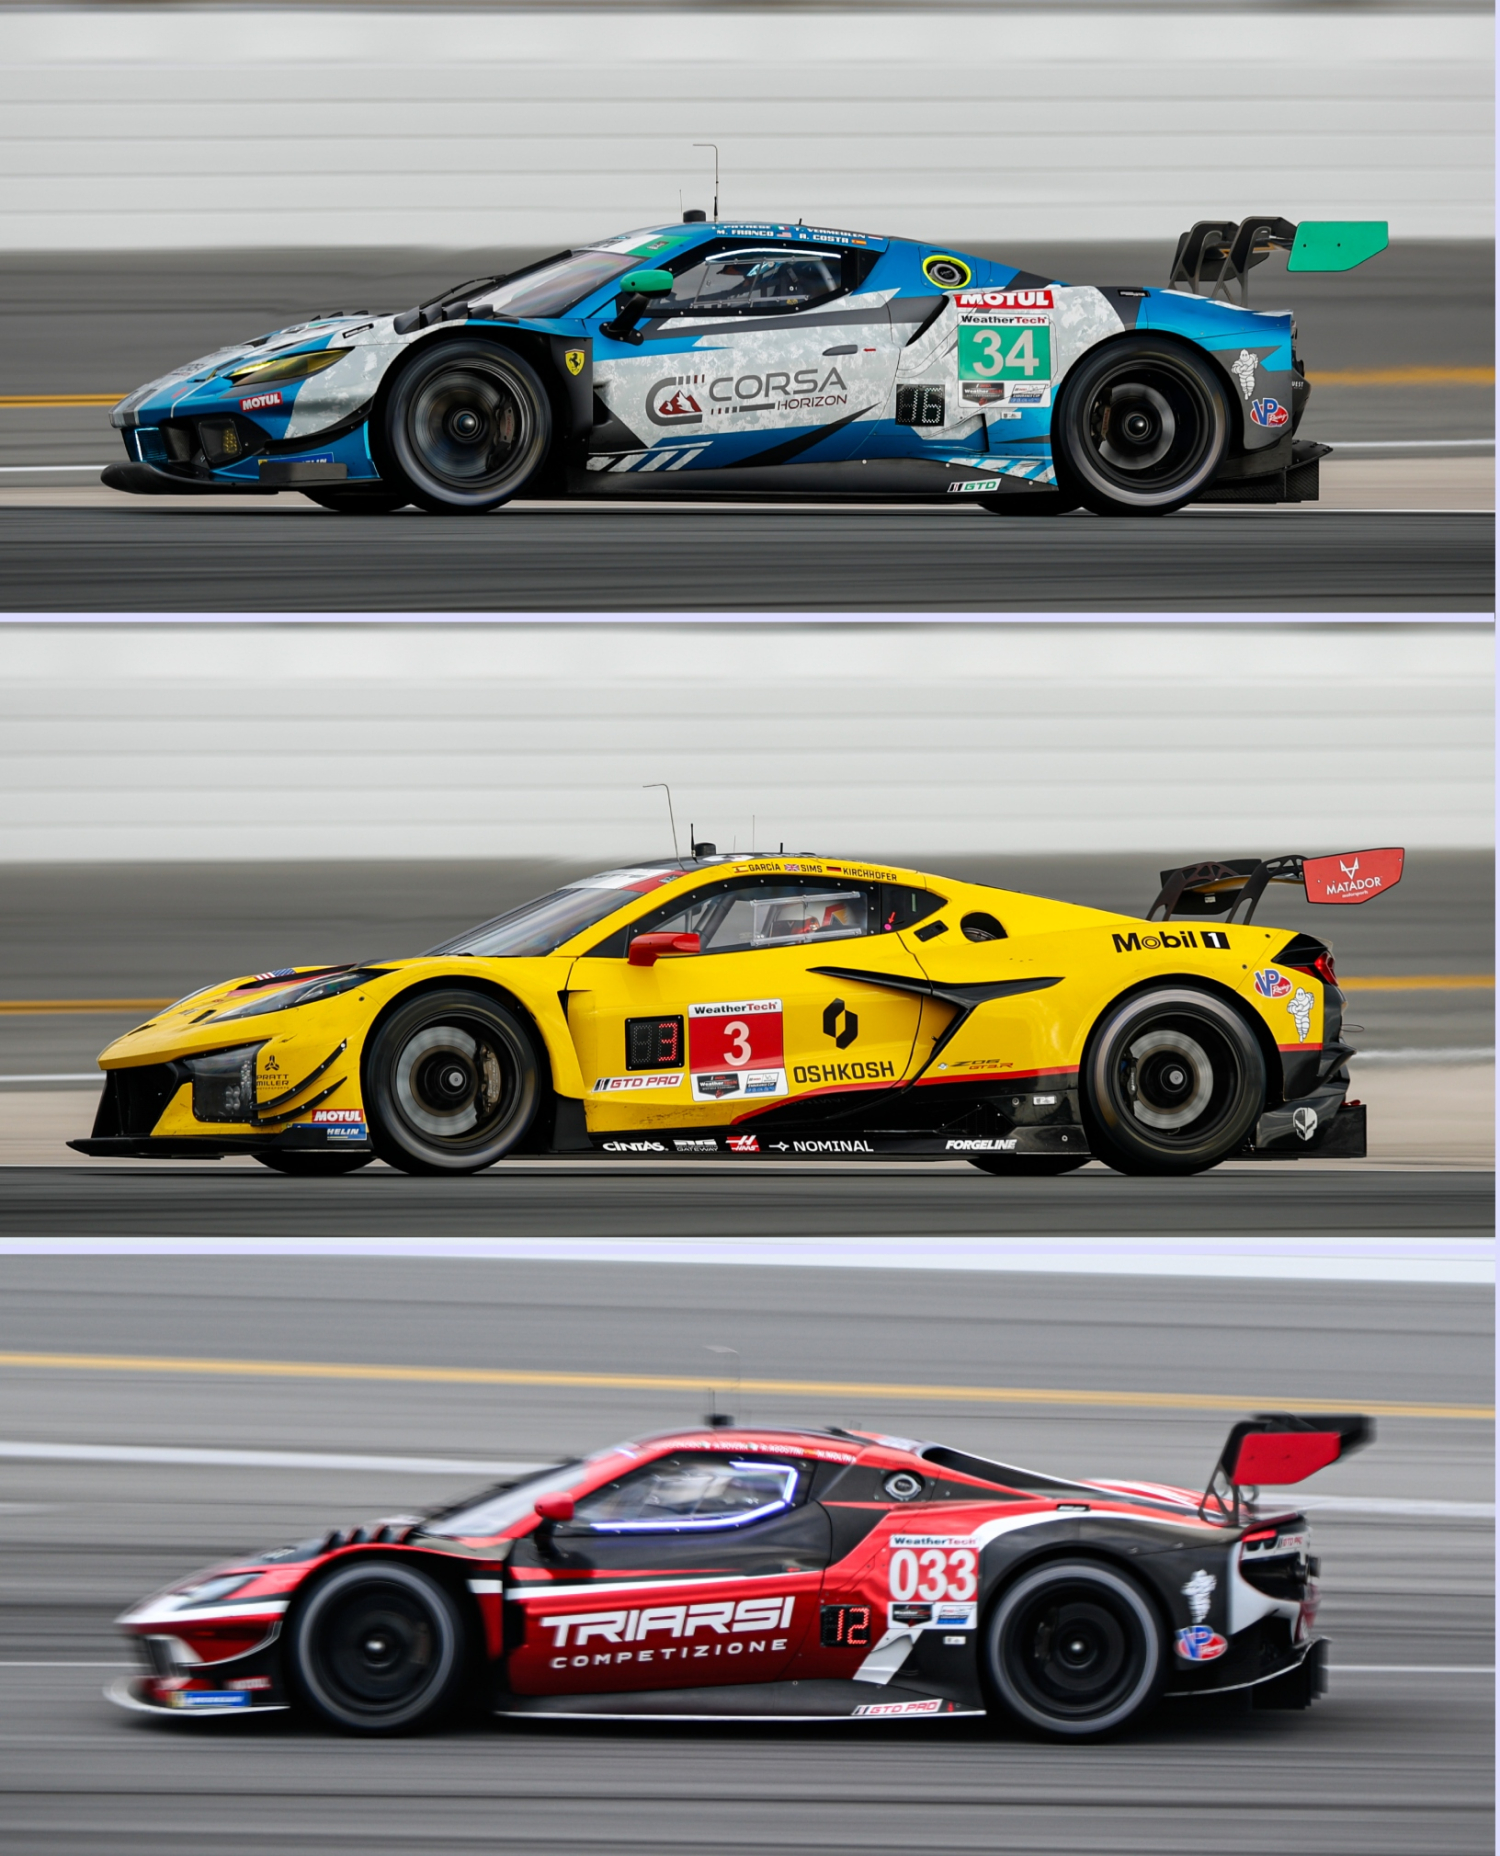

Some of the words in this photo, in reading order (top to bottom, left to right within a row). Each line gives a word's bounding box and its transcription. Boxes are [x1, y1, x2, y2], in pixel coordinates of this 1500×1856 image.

[960, 291, 1050, 307] MOTUL
[961, 315, 1046, 325] WeatherTech
[972, 329, 1040, 377] 34
[708, 367, 848, 402] CORSA
[242, 393, 281, 411] MOTUL
[777, 394, 848, 411] HORIZON
[1252, 398, 1279, 426] VP
[963, 481, 997, 491] GTD
[748, 862, 781, 872] GARCÍA
[801, 864, 823, 873] SIMS
[1326, 876, 1382, 895] MATADOR
[1112, 931, 1198, 953] Mobil
[1206, 932, 1221, 948] 1
[1255, 969, 1280, 997] VP
[1272, 983, 1292, 994] Racing
[694, 1002, 777, 1015] WeatherTech
[657, 1022, 678, 1062] 3
[723, 1020, 752, 1067] 3
[793, 1060, 895, 1084] OSHKOSH
[610, 1077, 643, 1089] GTD
[646, 1075, 681, 1086] PRO
[314, 1110, 361, 1121] MOTUL
[602, 1140, 665, 1152] CINTAS
[793, 1140, 874, 1152] NOMINAL
[946, 1139, 1017, 1150] FORGELINE
[894, 1537, 977, 1545] WeatherTech
[889, 1548, 977, 1601] 033
[540, 1596, 796, 1648] TRIARSI
[836, 1607, 870, 1645] 12
[550, 1638, 788, 1669] COMPETIZIONE
[869, 1705, 903, 1714] GTD
[905, 1702, 938, 1712] PRO
